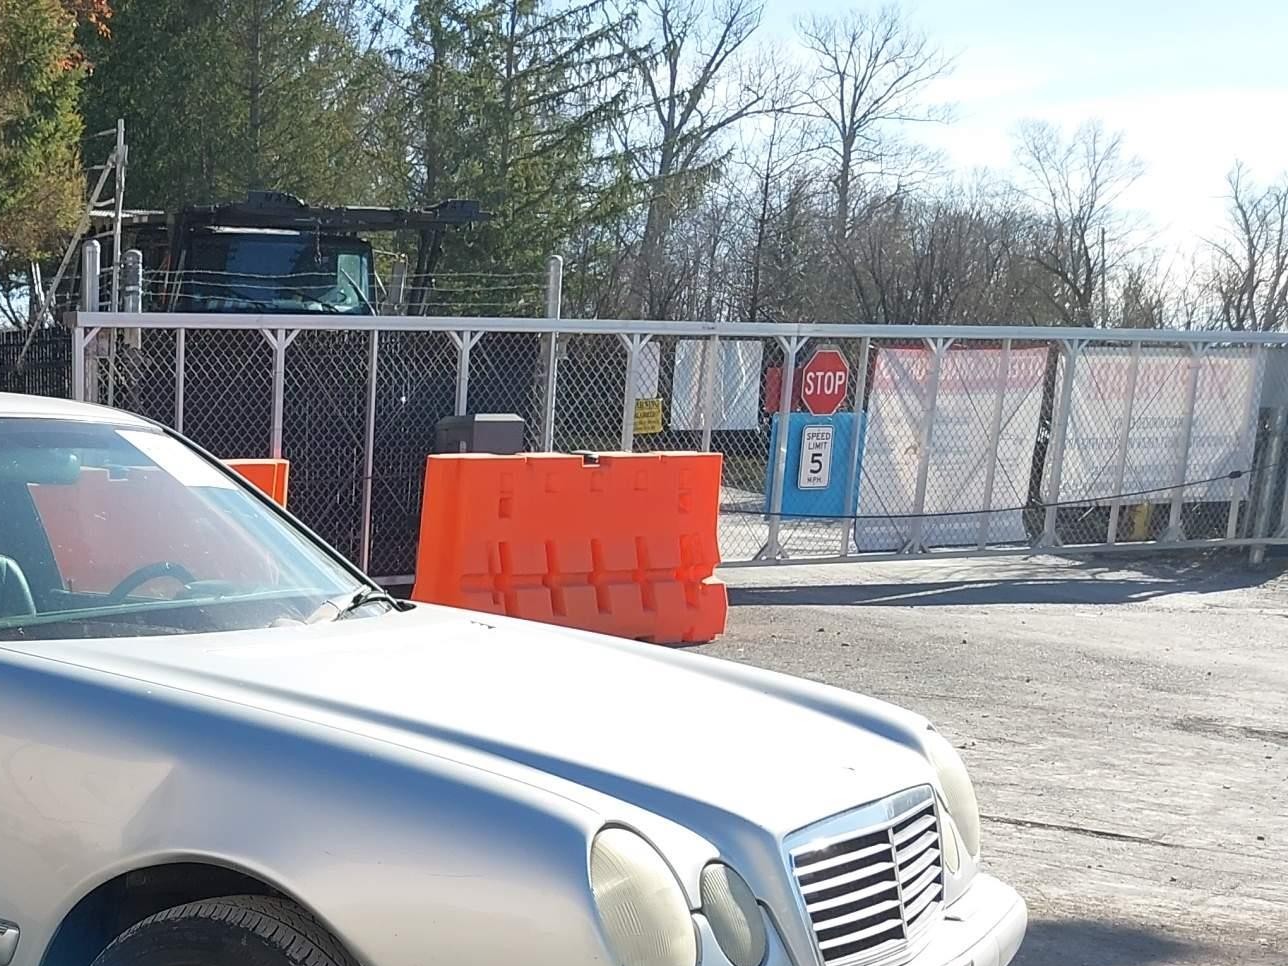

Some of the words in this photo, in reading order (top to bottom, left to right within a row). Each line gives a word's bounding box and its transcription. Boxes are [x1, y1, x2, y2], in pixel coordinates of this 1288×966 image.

[805, 371, 845, 395] STOP
[806, 432, 831, 441] SPEED
[808, 441, 828, 450] LIMIT
[809, 453, 823, 474] 5
